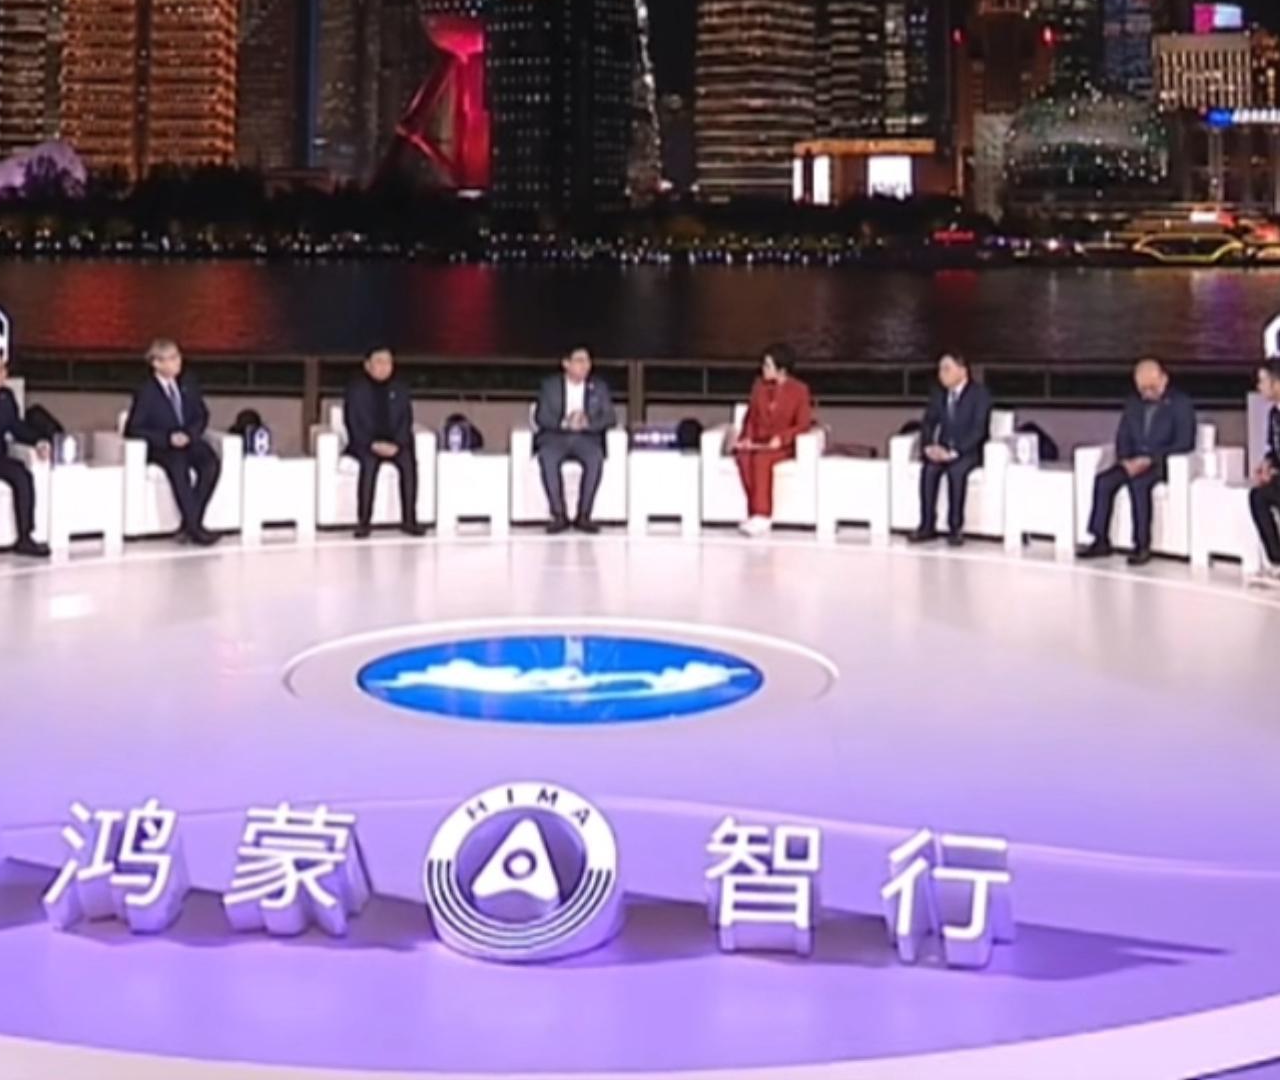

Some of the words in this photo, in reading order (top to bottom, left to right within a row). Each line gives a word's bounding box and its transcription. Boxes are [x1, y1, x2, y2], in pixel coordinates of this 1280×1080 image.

[465, 787, 591, 827] HIMA
[43, 797, 356, 909] 鸿蒙
[704, 814, 1012, 941] 智行
